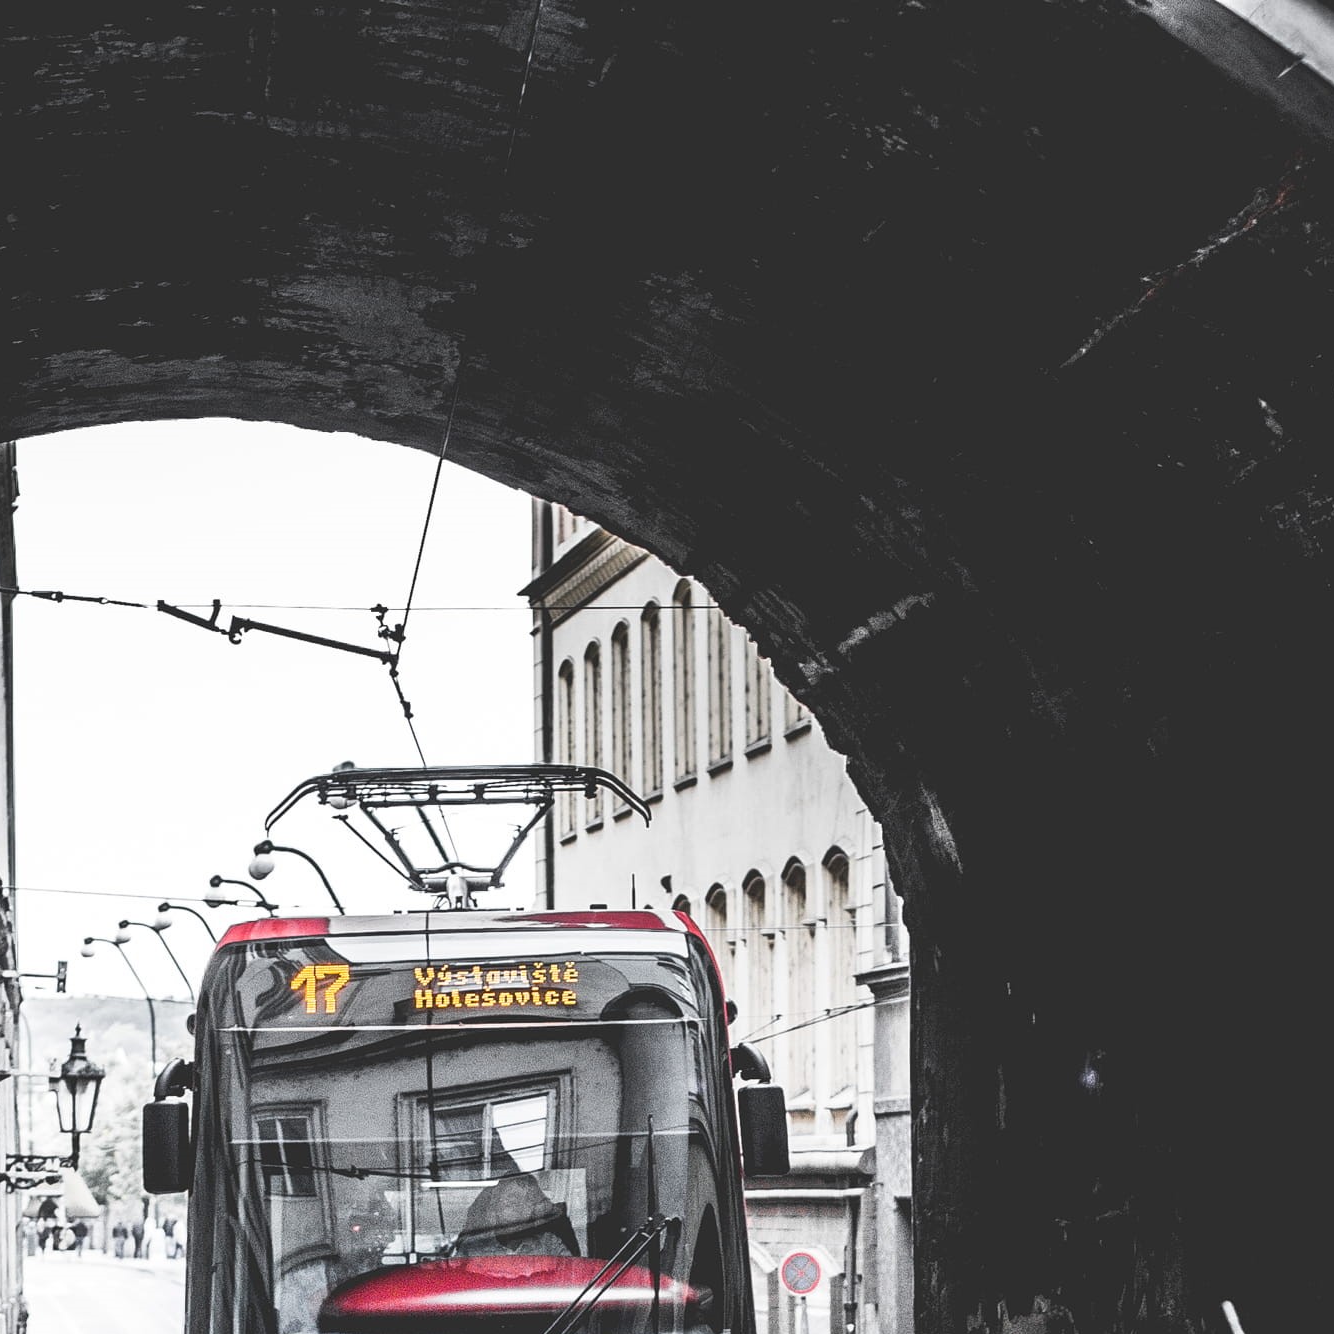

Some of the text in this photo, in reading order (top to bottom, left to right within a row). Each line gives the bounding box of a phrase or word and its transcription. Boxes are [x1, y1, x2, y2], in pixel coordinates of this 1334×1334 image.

[413, 962, 580, 986] Výstaviště
[290, 963, 351, 1014] 17
[414, 986, 578, 1009] Holešovice
